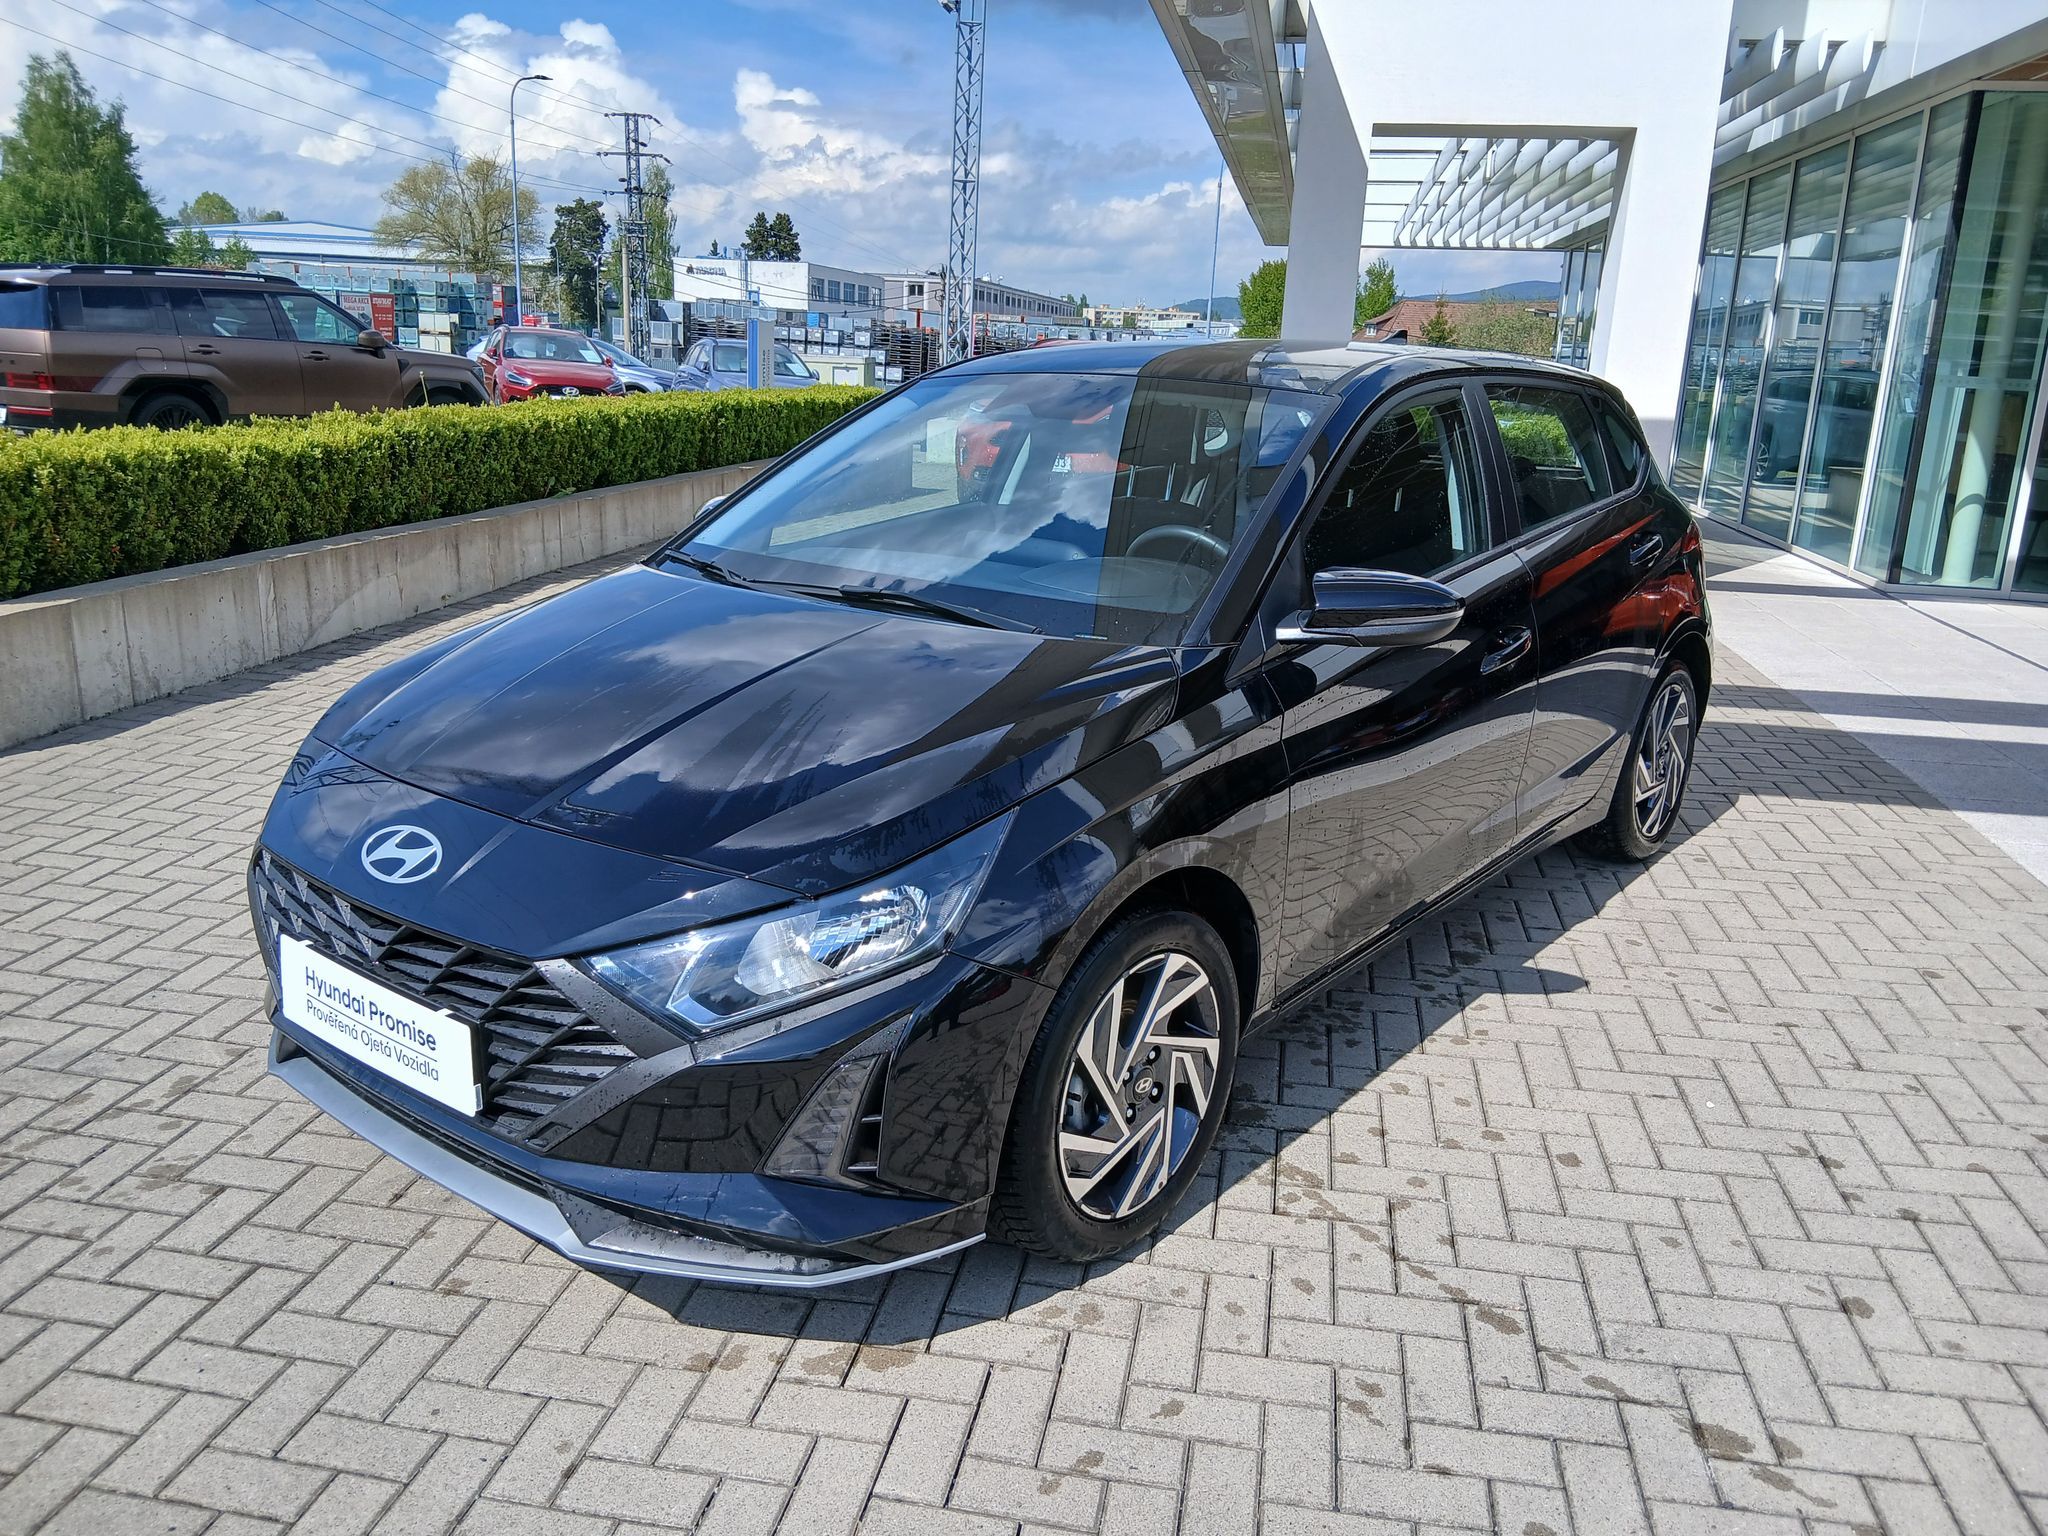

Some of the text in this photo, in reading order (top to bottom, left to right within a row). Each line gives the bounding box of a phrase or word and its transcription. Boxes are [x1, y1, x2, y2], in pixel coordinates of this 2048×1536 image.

[305, 966, 437, 1051] Hyundai Promise
[306, 999, 439, 1082] Prověřená Ojetá Vozidla
